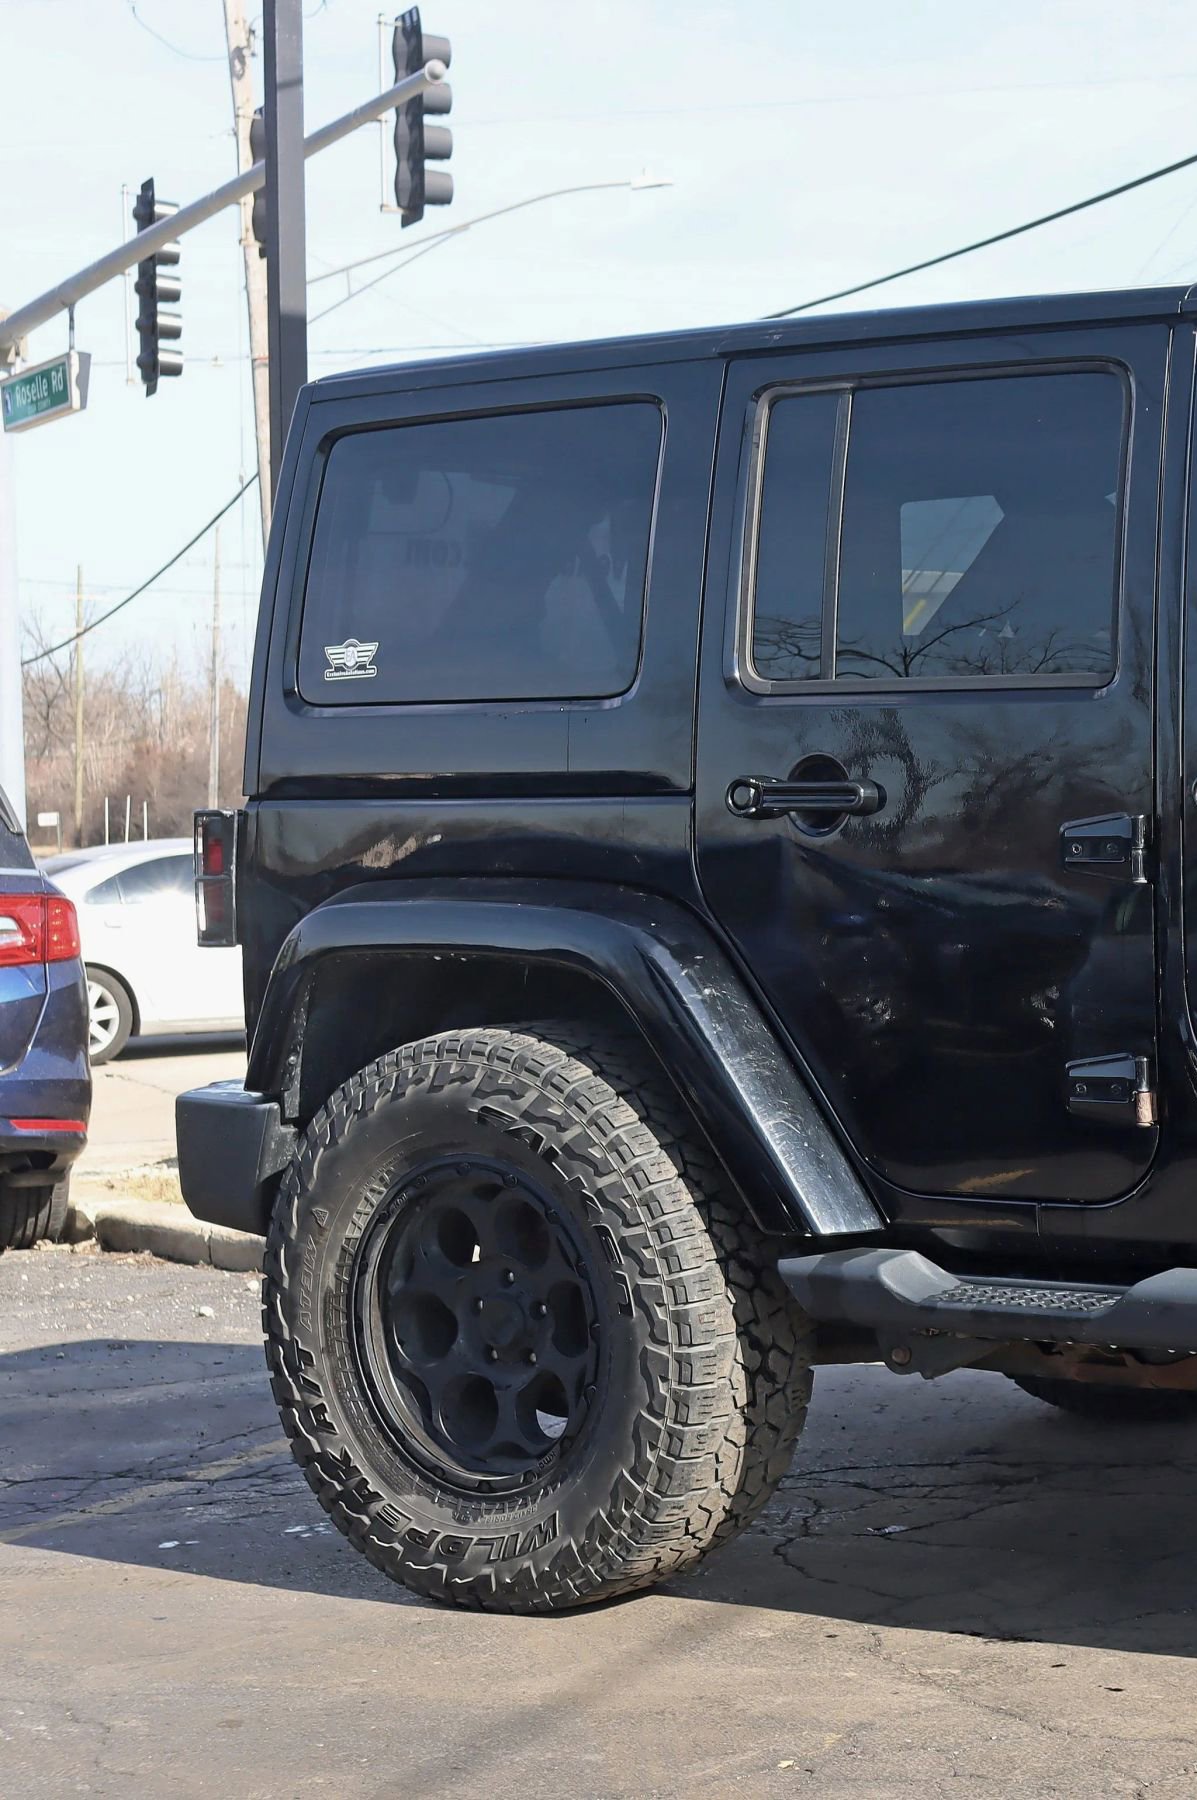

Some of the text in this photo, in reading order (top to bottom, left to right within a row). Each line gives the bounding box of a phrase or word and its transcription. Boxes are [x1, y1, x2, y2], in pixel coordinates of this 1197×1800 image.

[15, 375, 48, 408] Roselle
[51, 366, 64, 395] Rd
[298, 1235, 319, 1333] AT3W
[294, 1336, 560, 1562] WILDPEAK A/T
